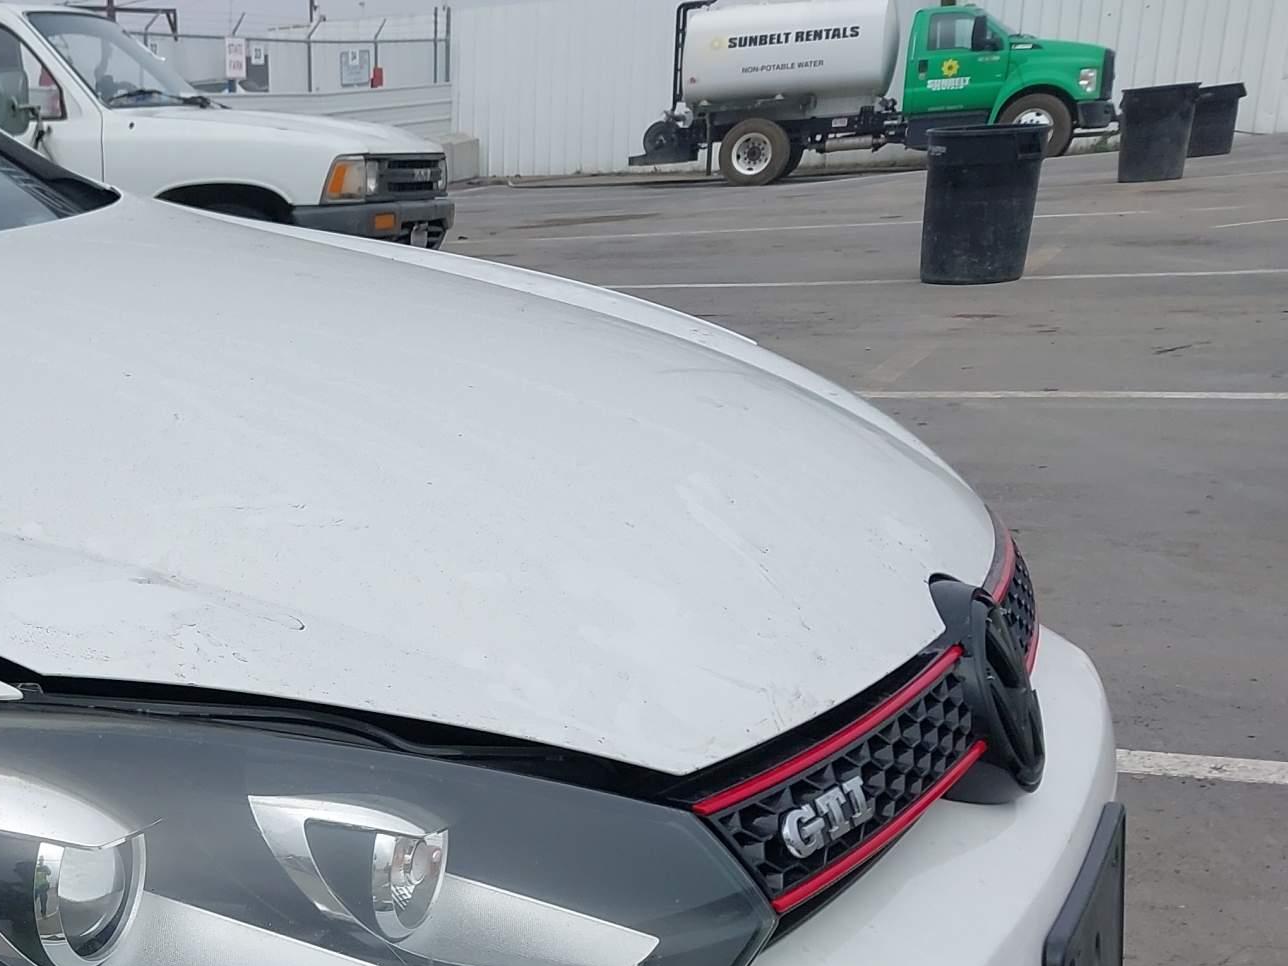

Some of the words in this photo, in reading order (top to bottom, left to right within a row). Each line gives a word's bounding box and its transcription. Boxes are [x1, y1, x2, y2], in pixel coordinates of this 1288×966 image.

[728, 32, 791, 49] SUNBELT
[795, 26, 860, 43] RENTALS
[741, 62, 795, 74] NON-POTABLE
[797, 59, 824, 70] WATER
[781, 775, 874, 858] GTI
